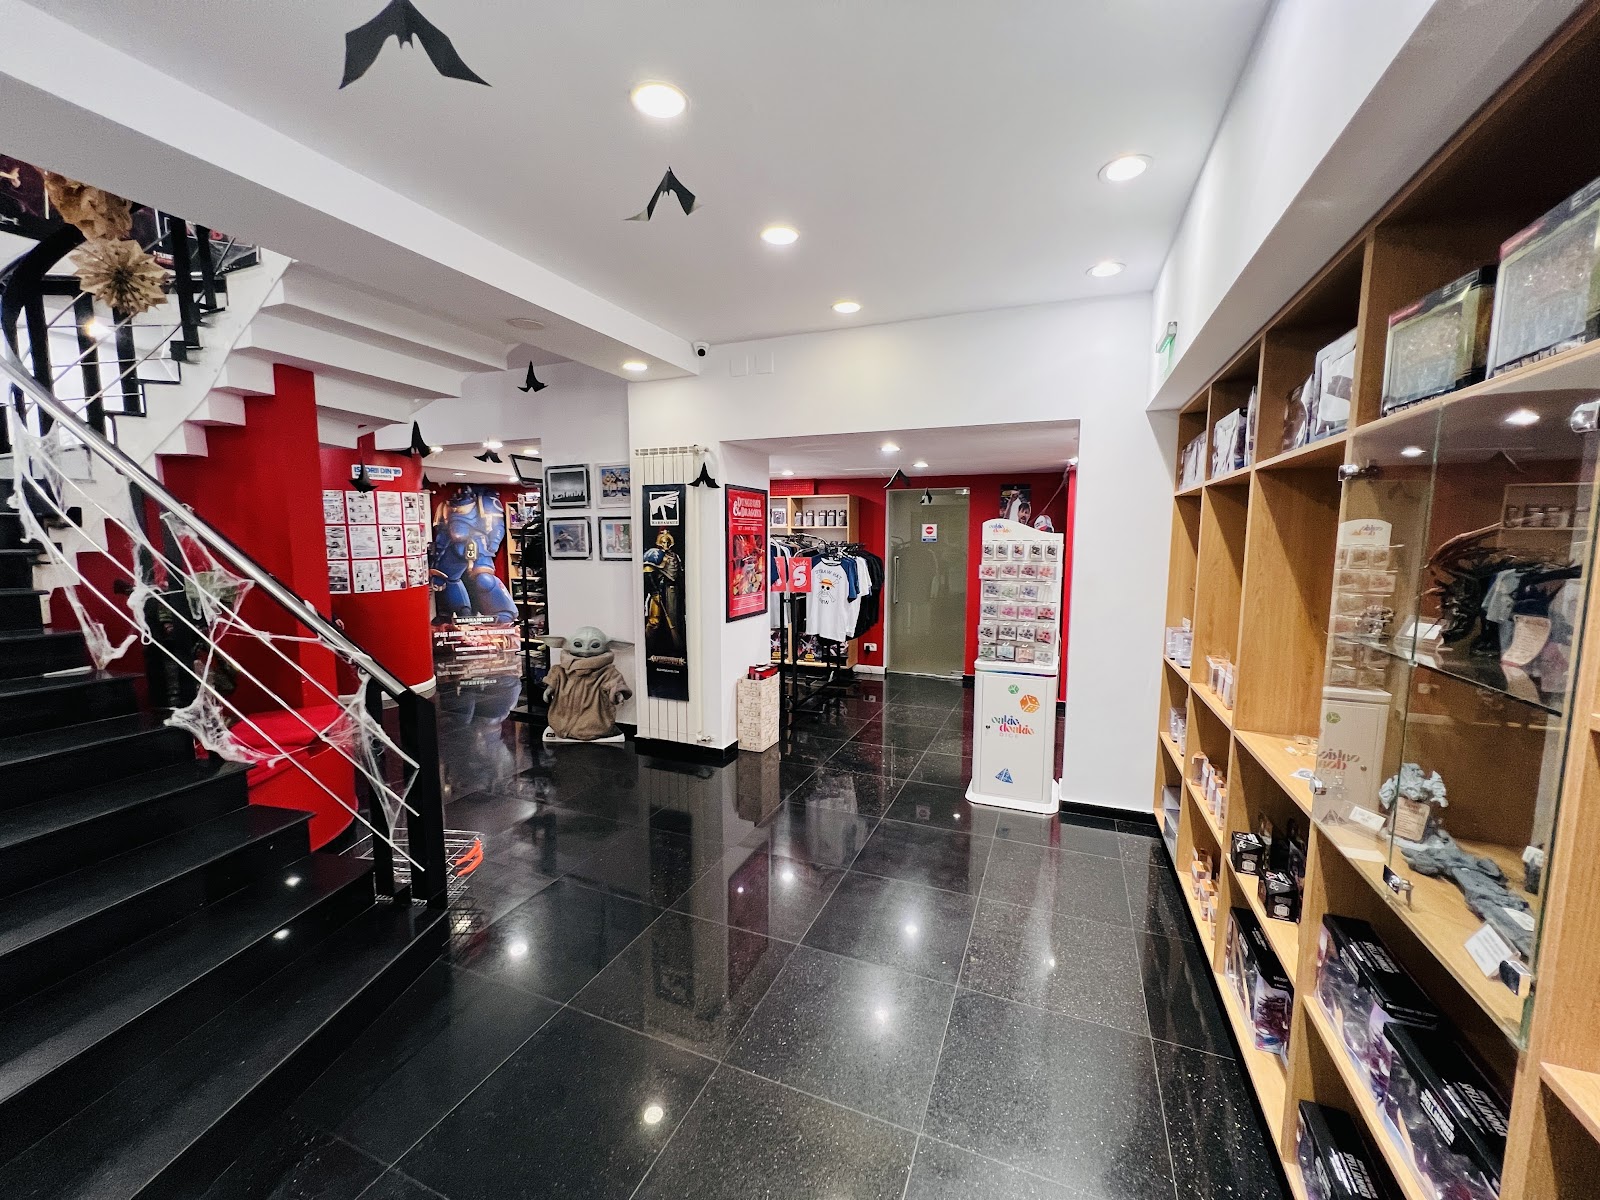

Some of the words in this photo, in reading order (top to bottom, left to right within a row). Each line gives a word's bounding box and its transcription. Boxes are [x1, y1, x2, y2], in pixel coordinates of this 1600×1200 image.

[354, 466, 379, 474] ISORII
[380, 467, 392, 475] DIN
[456, 616, 495, 624] WARHAMMER
[991, 714, 1020, 726] oakie
[1000, 723, 1035, 735] doakie
